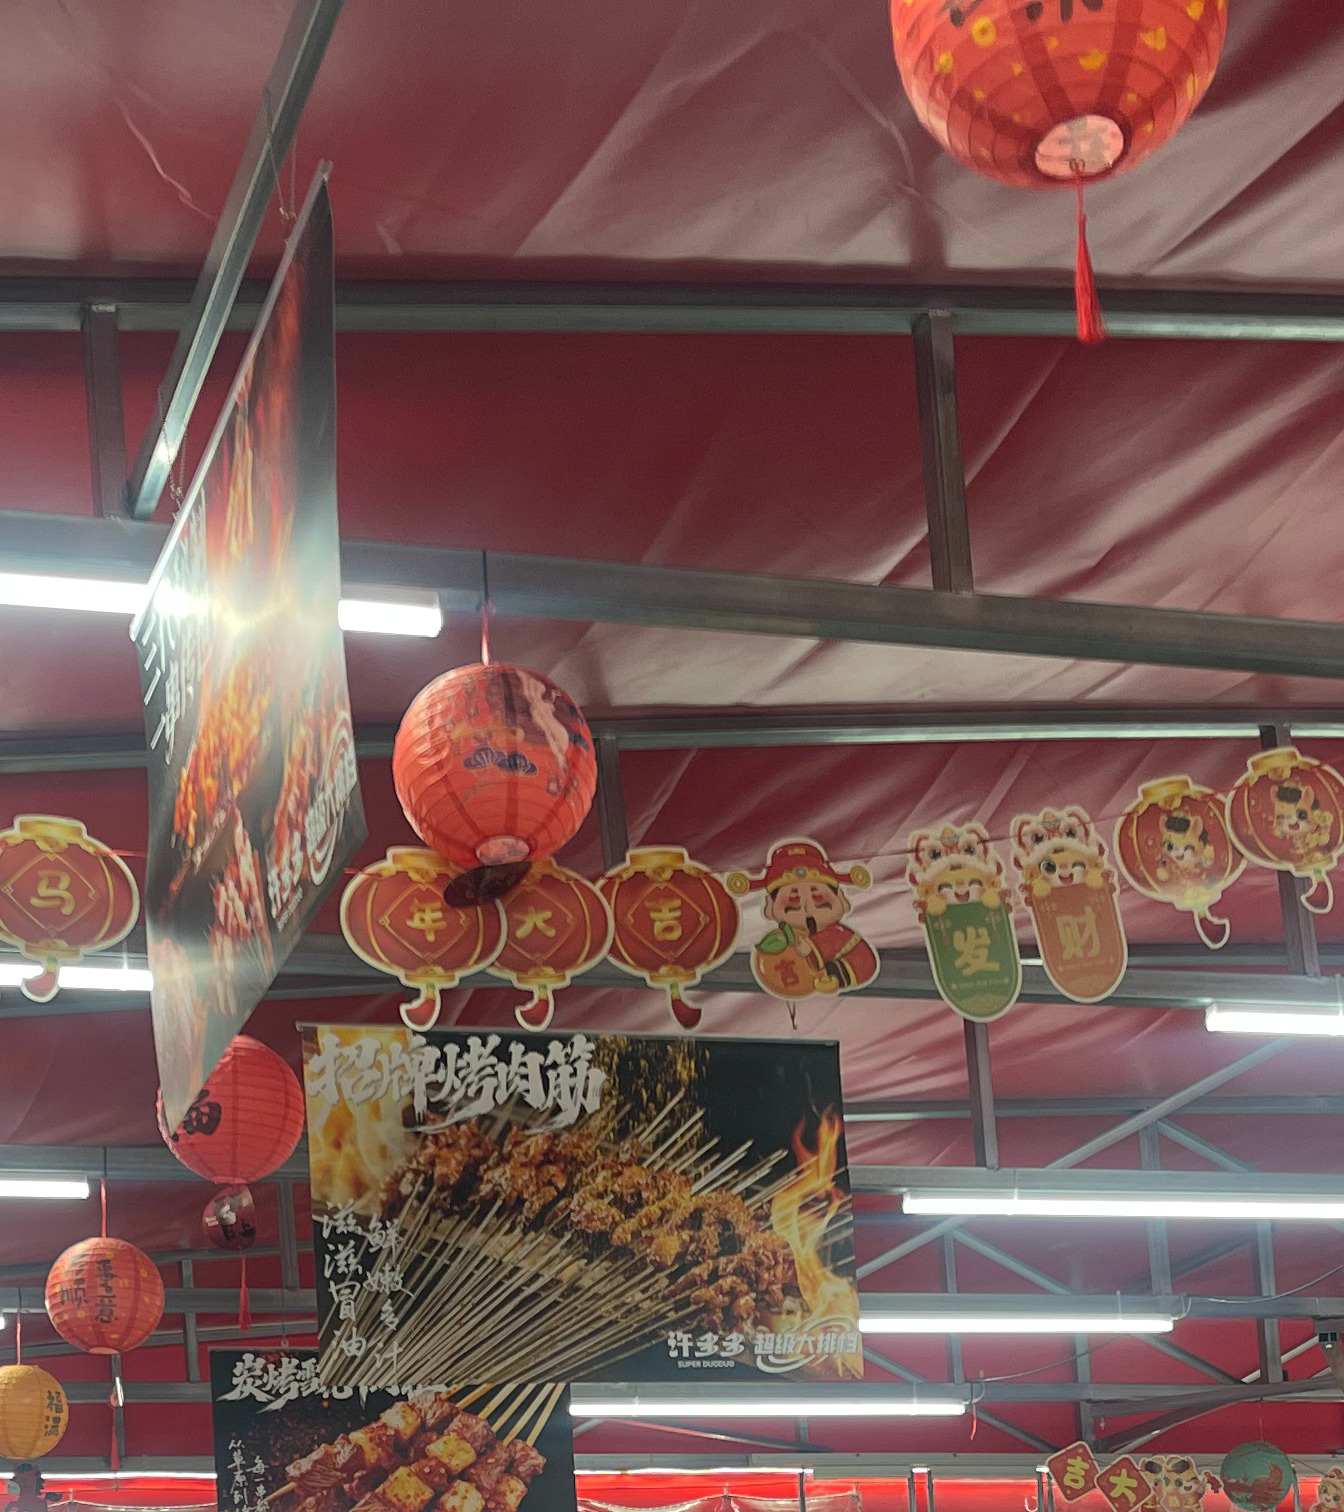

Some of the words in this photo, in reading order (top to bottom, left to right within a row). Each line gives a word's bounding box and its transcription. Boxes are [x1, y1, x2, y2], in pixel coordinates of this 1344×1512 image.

[31, 873, 75, 915] 马
[405, 901, 445, 940] 年
[515, 906, 555, 939] 大
[653, 901, 683, 940] 吉
[1056, 907, 1102, 960] 财
[953, 927, 1001, 976] 发
[305, 1035, 608, 1134] 招牌烤肉筋
[322, 1199, 368, 1361] 滋滋冒油
[667, 1331, 745, 1359] 许多多
[754, 1331, 859, 1356] 超级大排档
[1065, 1455, 1089, 1488] 吉
[1110, 1472, 1138, 1502] 大
